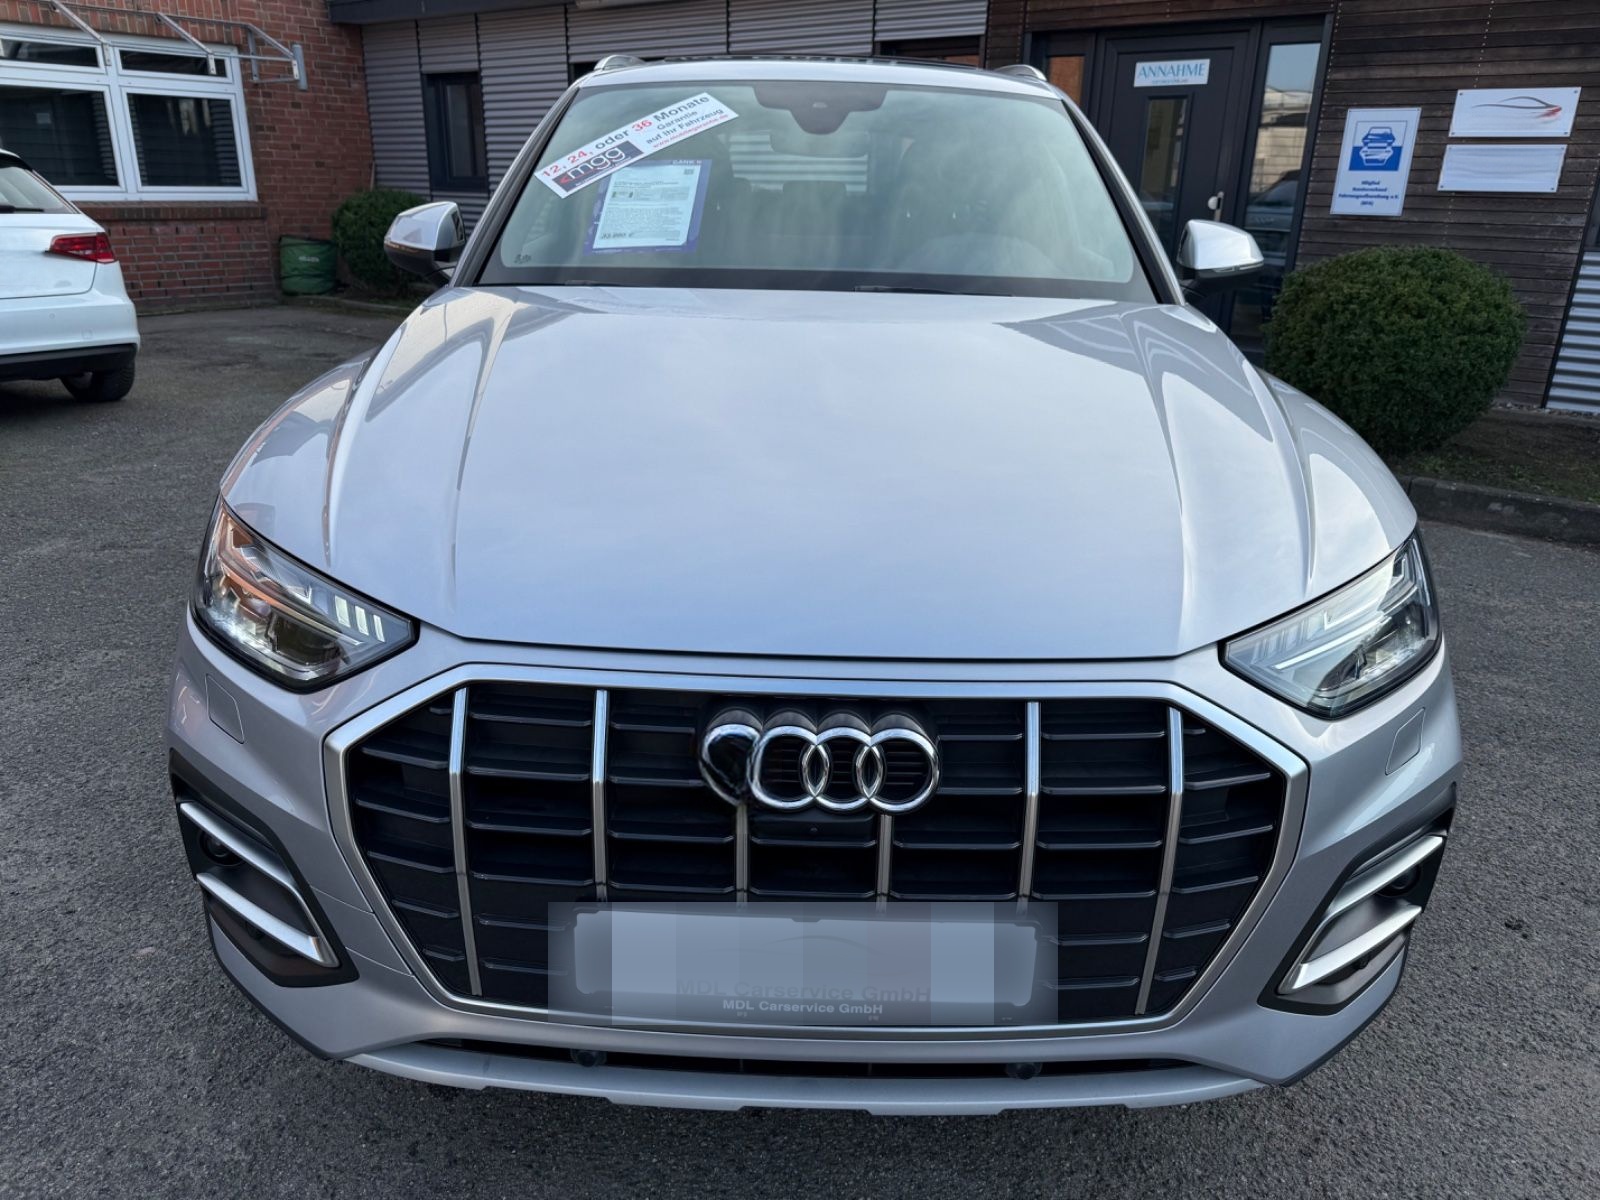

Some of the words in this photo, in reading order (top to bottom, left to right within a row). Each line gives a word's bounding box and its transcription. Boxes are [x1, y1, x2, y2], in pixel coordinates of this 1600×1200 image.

[1138, 63, 1206, 78] ANNAHME
[595, 129, 629, 149] oder
[631, 120, 653, 132] 36
[653, 97, 710, 122] Monate
[646, 134, 662, 144] auf
[679, 109, 724, 129] Fahrzeug
[657, 111, 698, 130] Garantie
[567, 147, 625, 178] mgg
[675, 979, 727, 996] MDL
[733, 981, 854, 1000] Carservice
[861, 984, 931, 1002] GmbH
[722, 1000, 755, 1010] MDL
[759, 1001, 835, 1013] Carservice
[839, 1004, 883, 1014] GmbH
